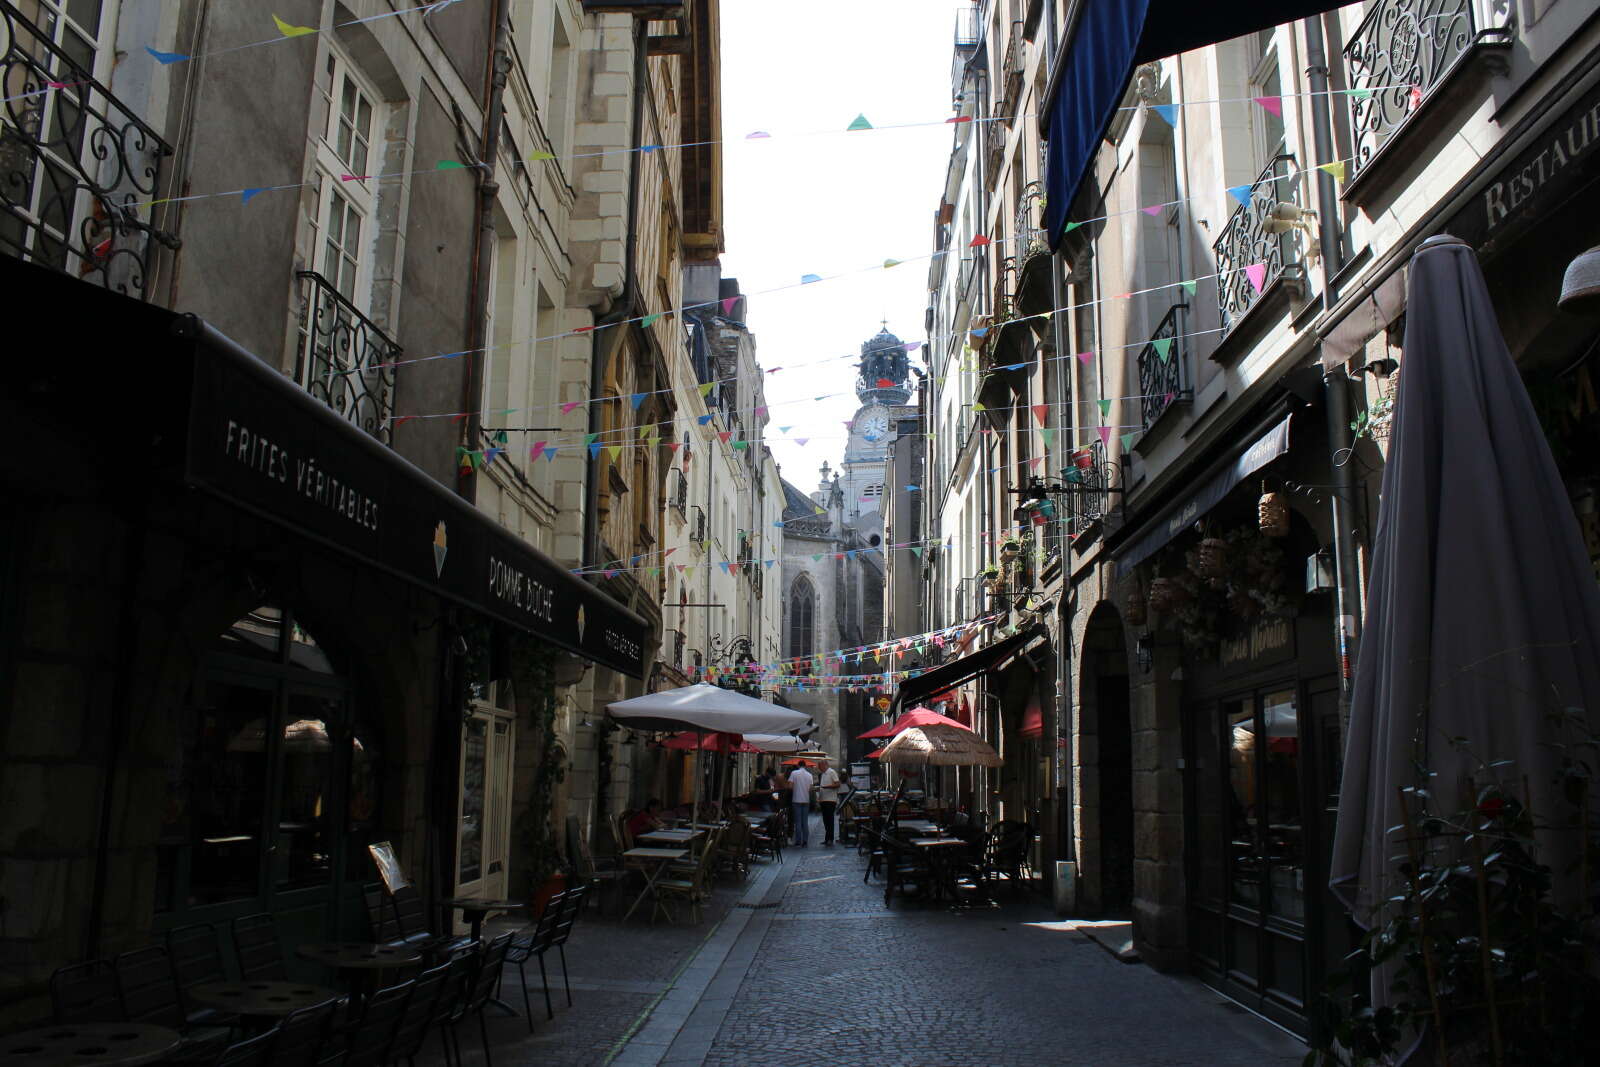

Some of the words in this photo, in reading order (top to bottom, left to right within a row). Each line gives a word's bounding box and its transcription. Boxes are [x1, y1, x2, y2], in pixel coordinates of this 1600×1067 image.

[225, 418, 289, 484] FRITES
[296, 457, 378, 532] VÉRITABLES
[489, 555, 523, 608] POMME
